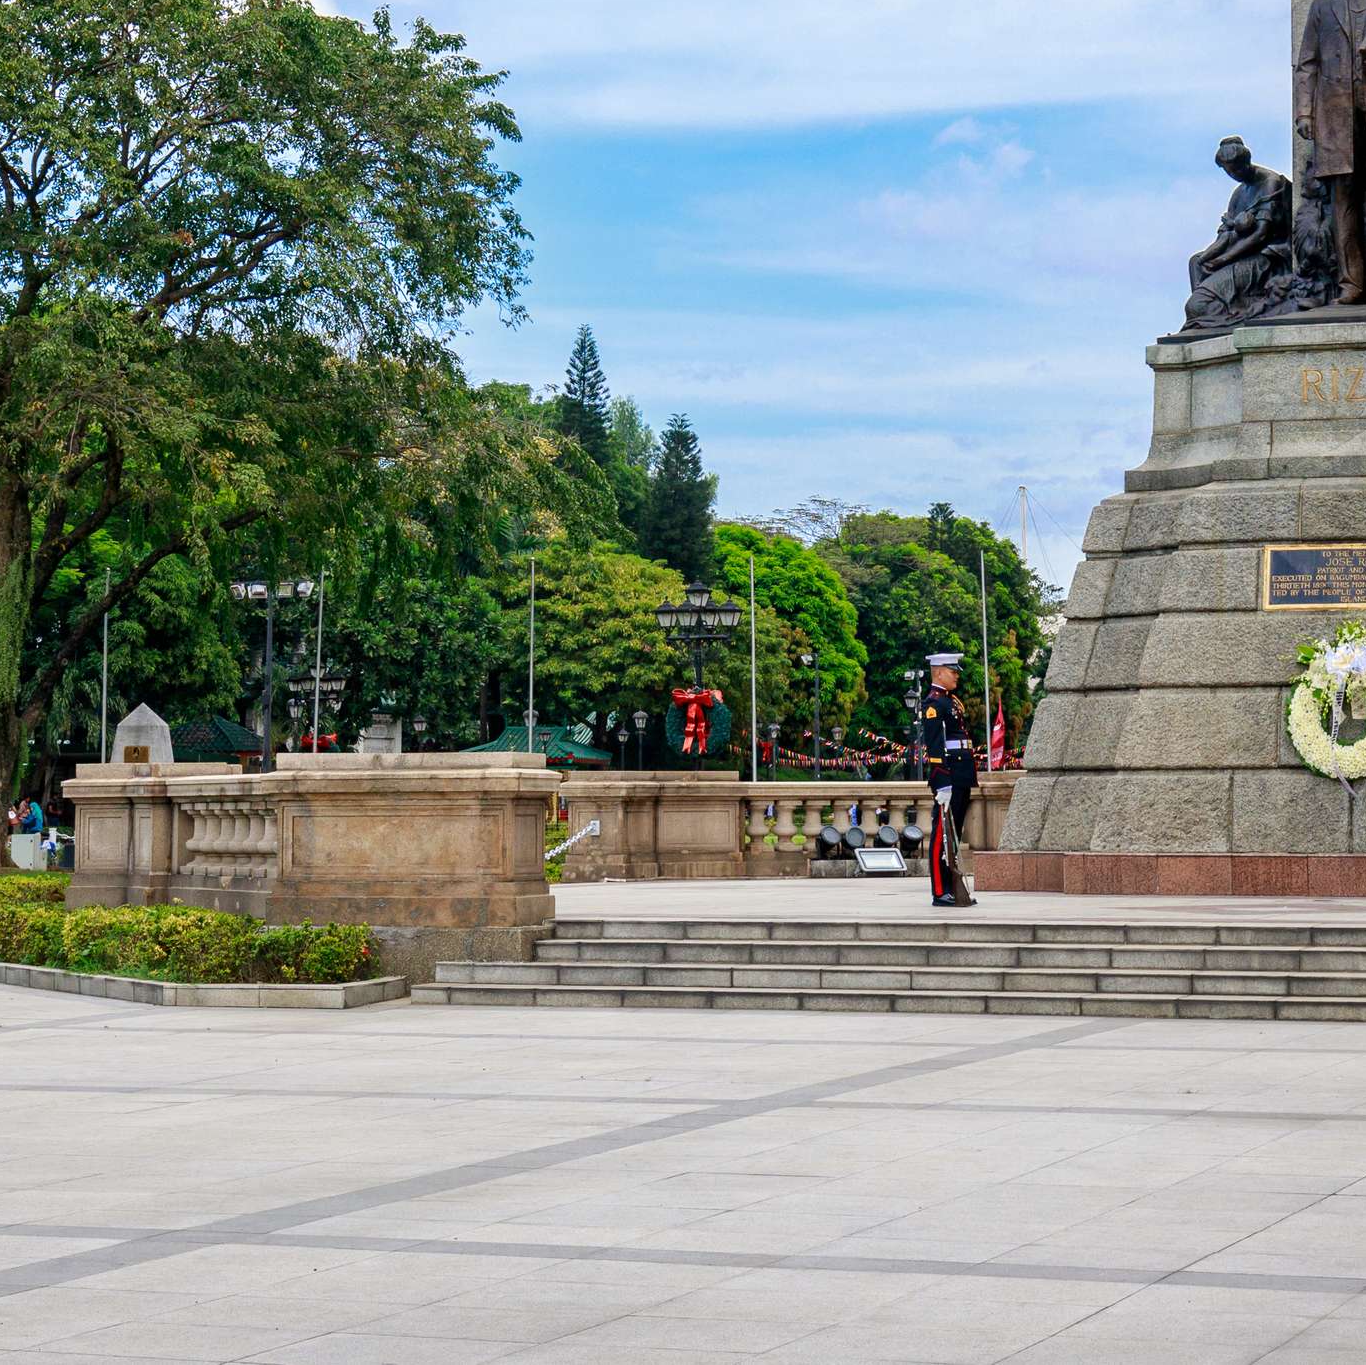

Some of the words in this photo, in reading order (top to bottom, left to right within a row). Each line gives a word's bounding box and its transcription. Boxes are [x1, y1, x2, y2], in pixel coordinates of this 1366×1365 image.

[1322, 550, 1332, 558] TO
[1325, 558, 1354, 567] JOSE
[1348, 566, 1364, 574] AND
[1315, 574, 1327, 582] ON
[1272, 582, 1311, 590] THIRTIETH
[1331, 581, 1350, 589] THIS
[1272, 589, 1288, 597] TED
[1290, 589, 1300, 597] BY
[1303, 589, 1320, 597] THE
[1355, 588, 1365, 596] OF
